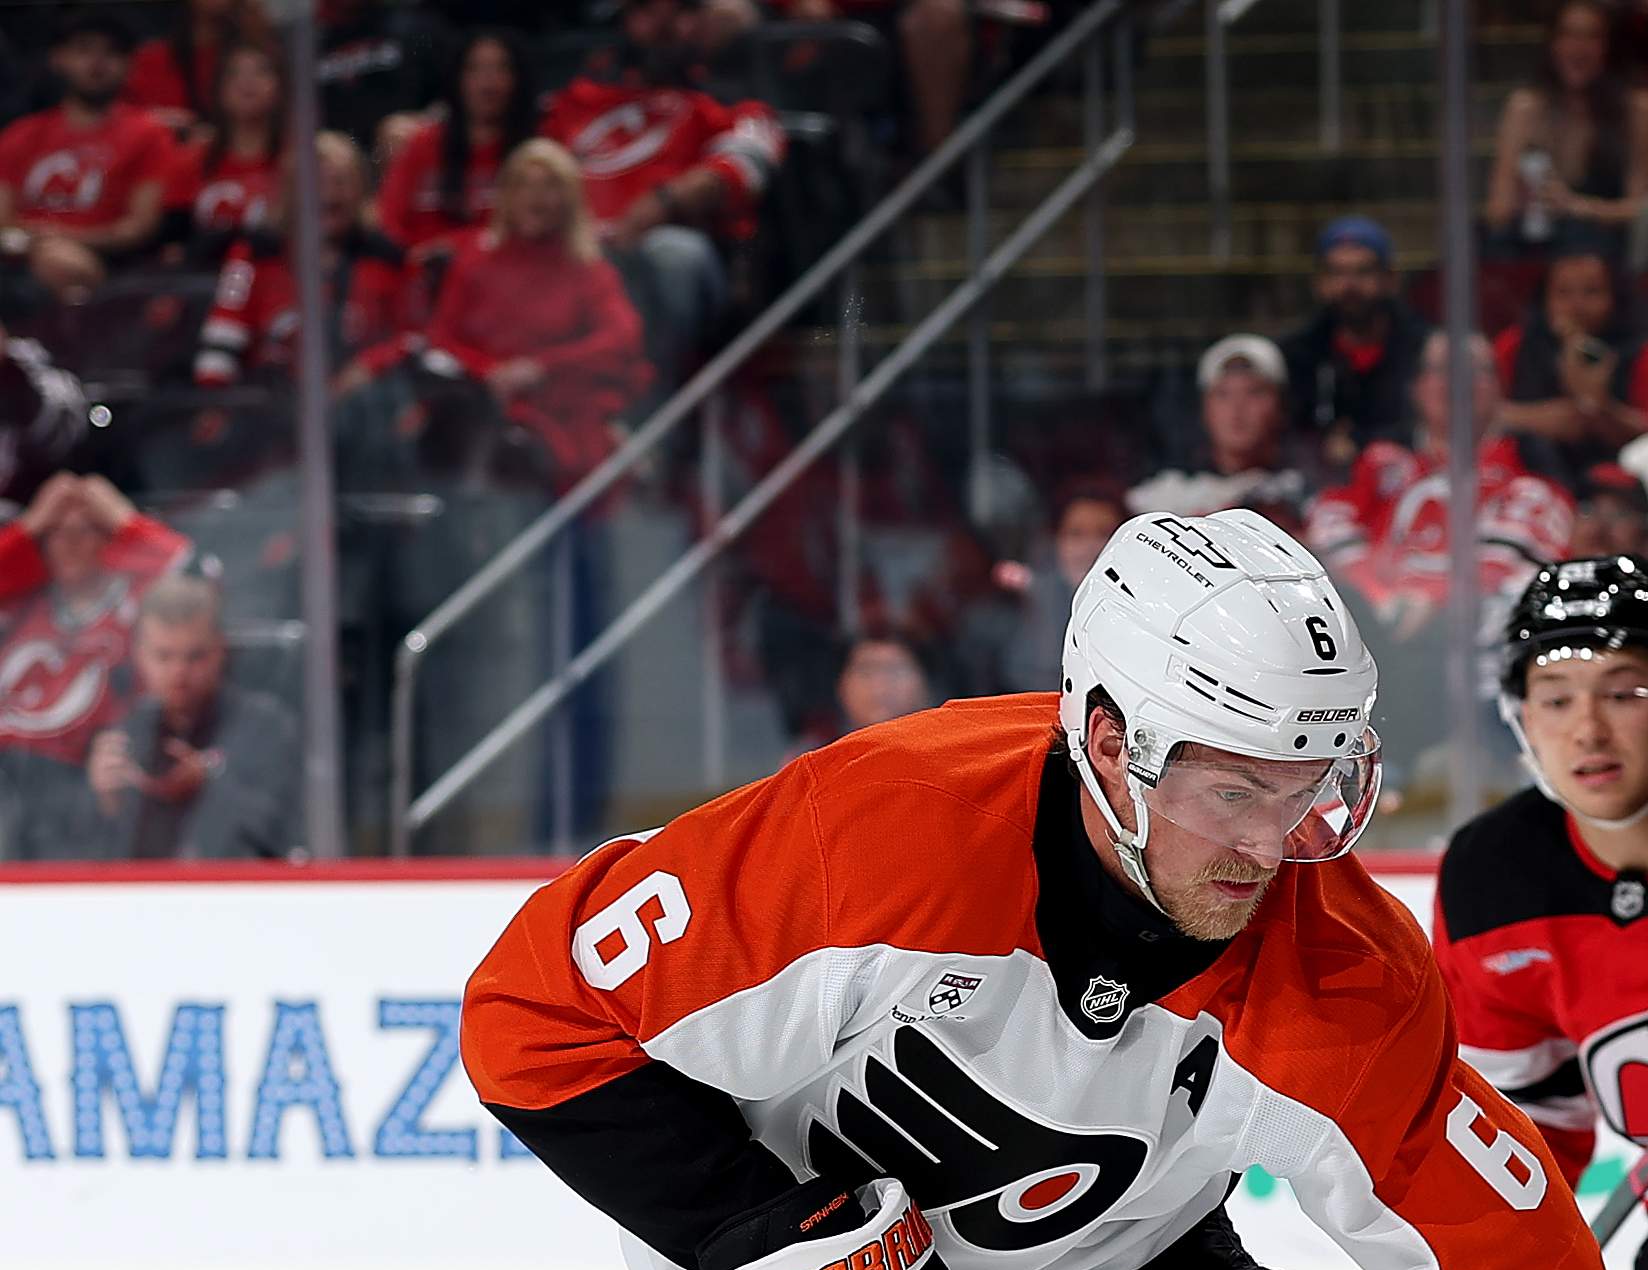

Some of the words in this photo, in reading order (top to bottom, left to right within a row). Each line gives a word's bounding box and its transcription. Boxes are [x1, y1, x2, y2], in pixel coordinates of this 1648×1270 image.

[1136, 532, 1215, 588] CHEVROLET
[1305, 616, 1338, 661] 6
[1296, 708, 1361, 722] BAUER
[571, 869, 692, 992] 6
[1089, 993, 1119, 1010] NHL
[0, 998, 537, 1162] AMAZ
[1171, 1035, 1220, 1117] A
[1445, 1094, 1549, 1212] 6
